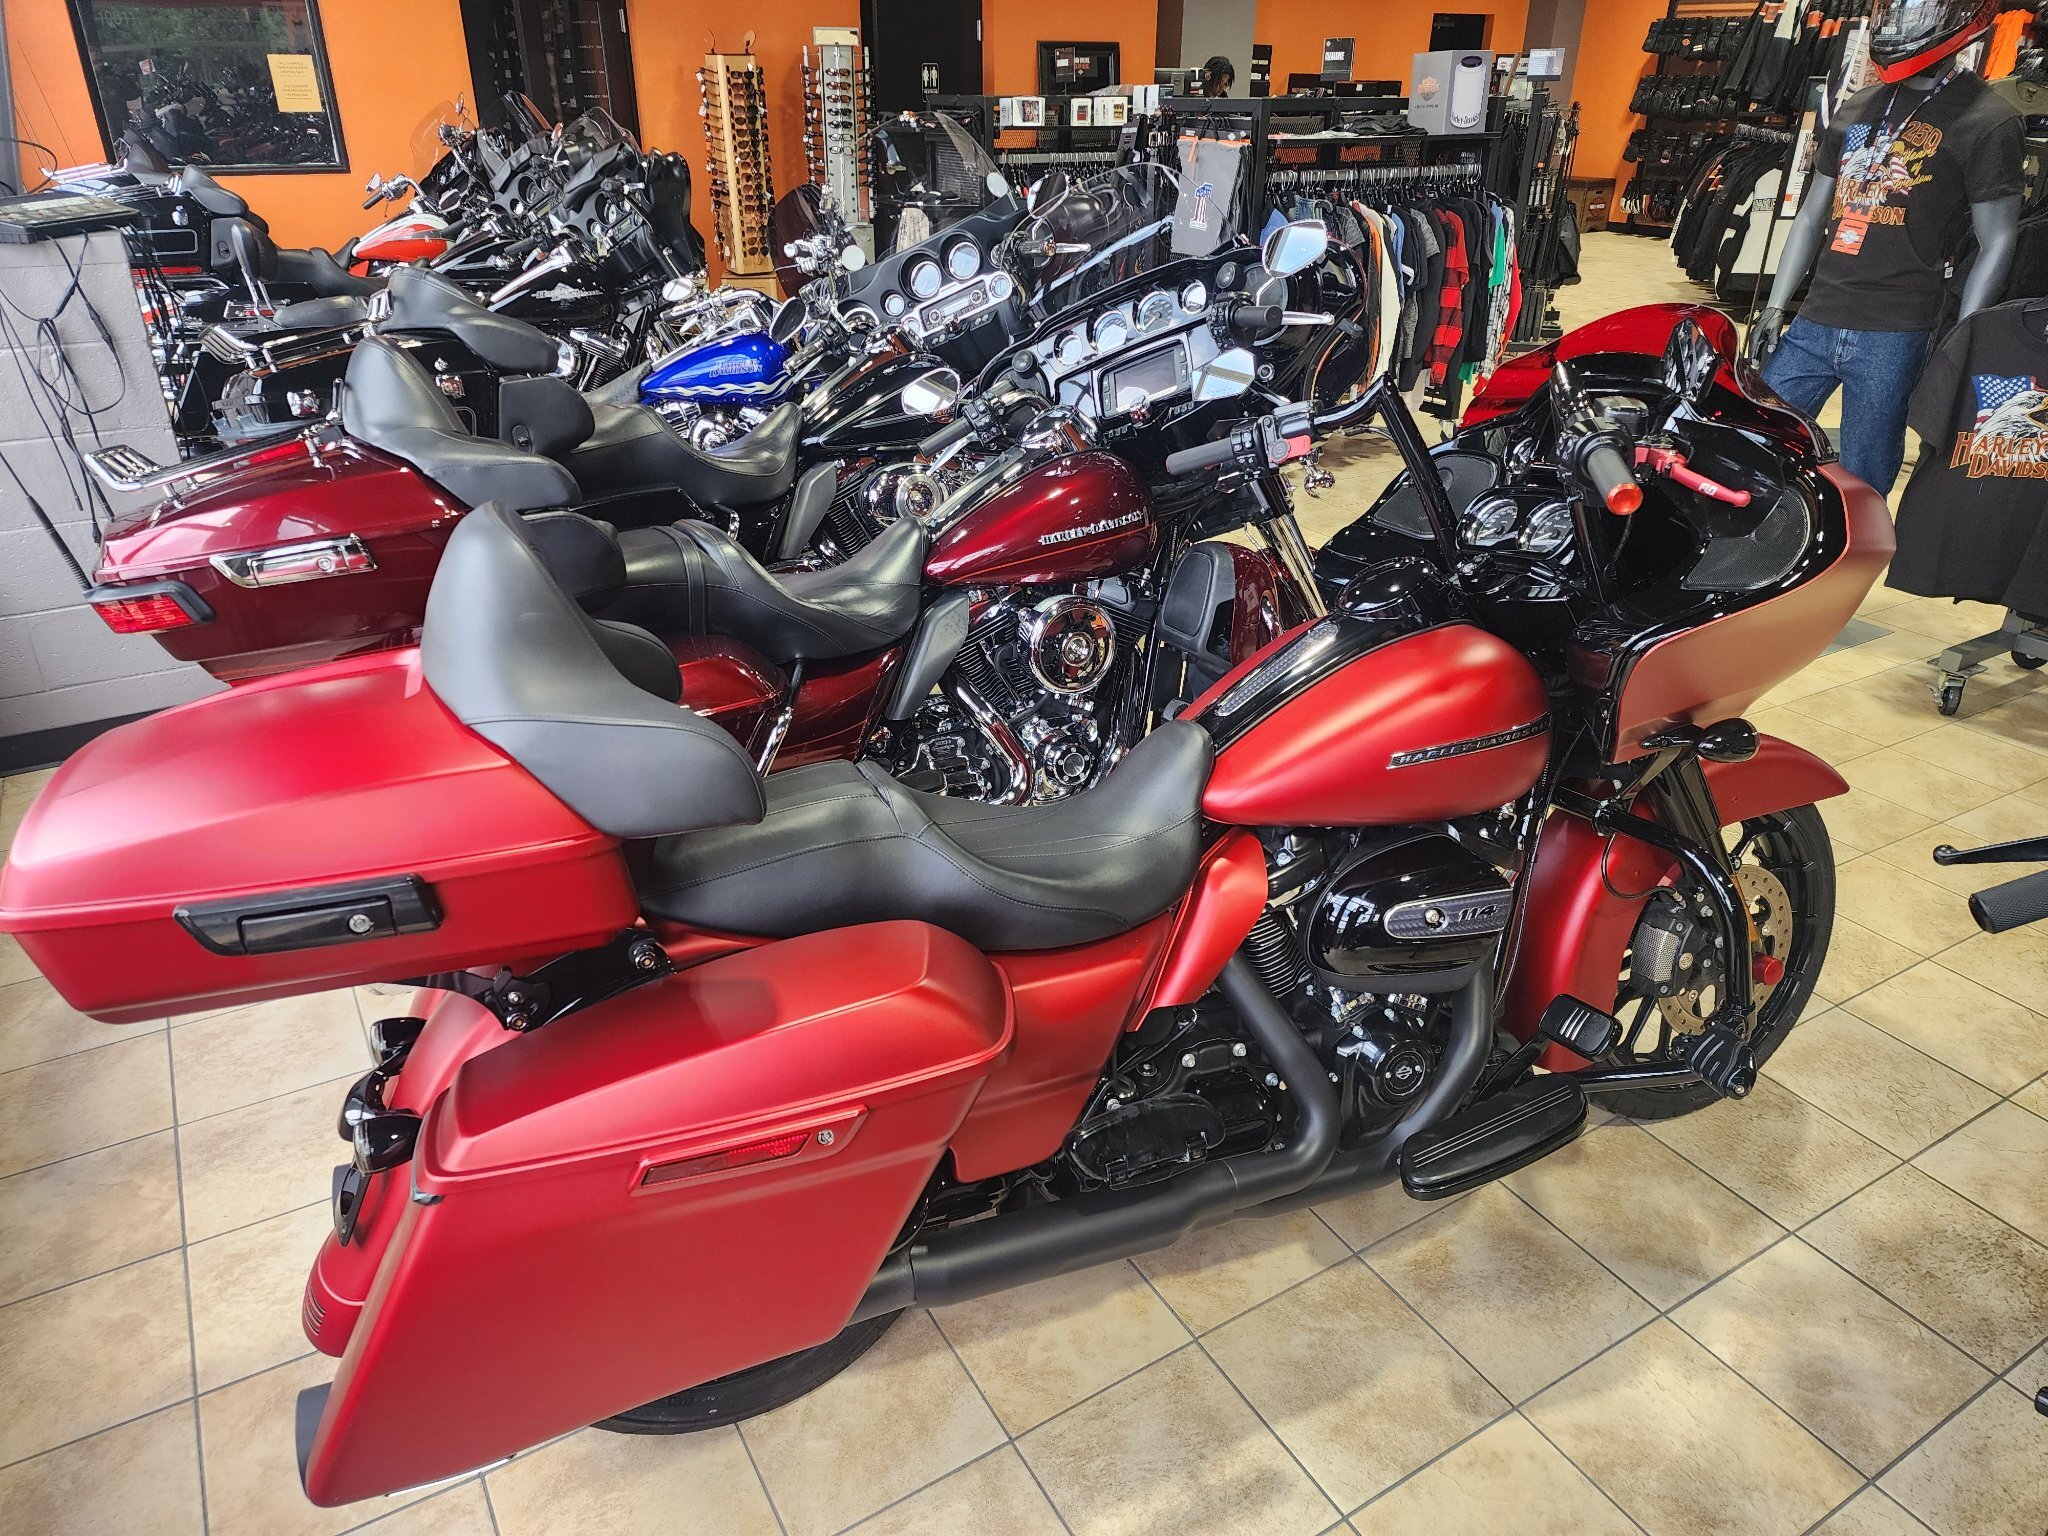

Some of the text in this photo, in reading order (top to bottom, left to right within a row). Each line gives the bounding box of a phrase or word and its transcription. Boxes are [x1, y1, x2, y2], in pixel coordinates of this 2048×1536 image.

[1902, 120, 1943, 148] 250
[1832, 196, 1907, 226] DASON
[1949, 431, 2047, 469] HARLEY
[1966, 453, 2048, 480] DAVIDS
[1459, 904, 1499, 922] 114
